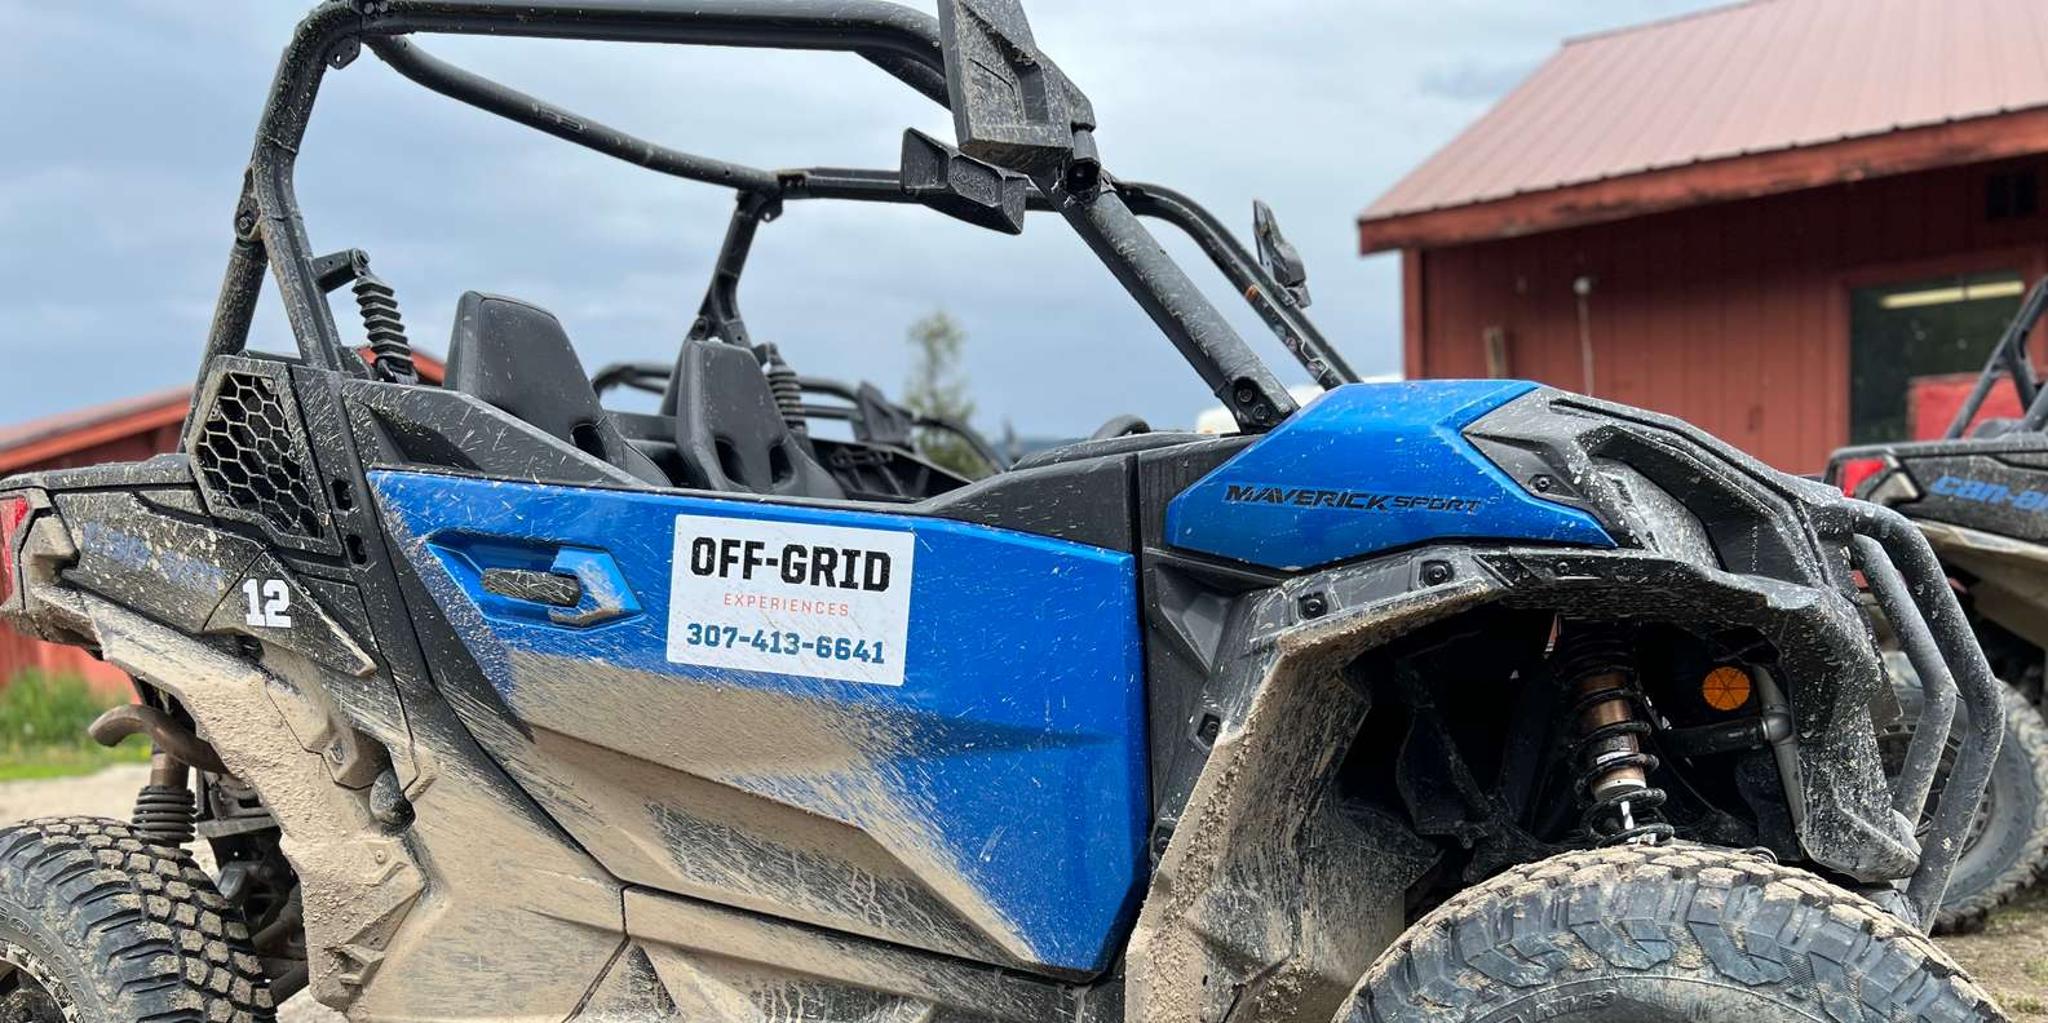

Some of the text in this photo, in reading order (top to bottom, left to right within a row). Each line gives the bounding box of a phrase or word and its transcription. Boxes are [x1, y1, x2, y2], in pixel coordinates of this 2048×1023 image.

[1224, 484, 1482, 513] MAVERICK SPORT
[690, 536, 891, 592] OFF-GRID
[242, 578, 292, 628] 12
[723, 592, 849, 617] EXPERIENCES
[686, 623, 885, 664] 307-413-6641
